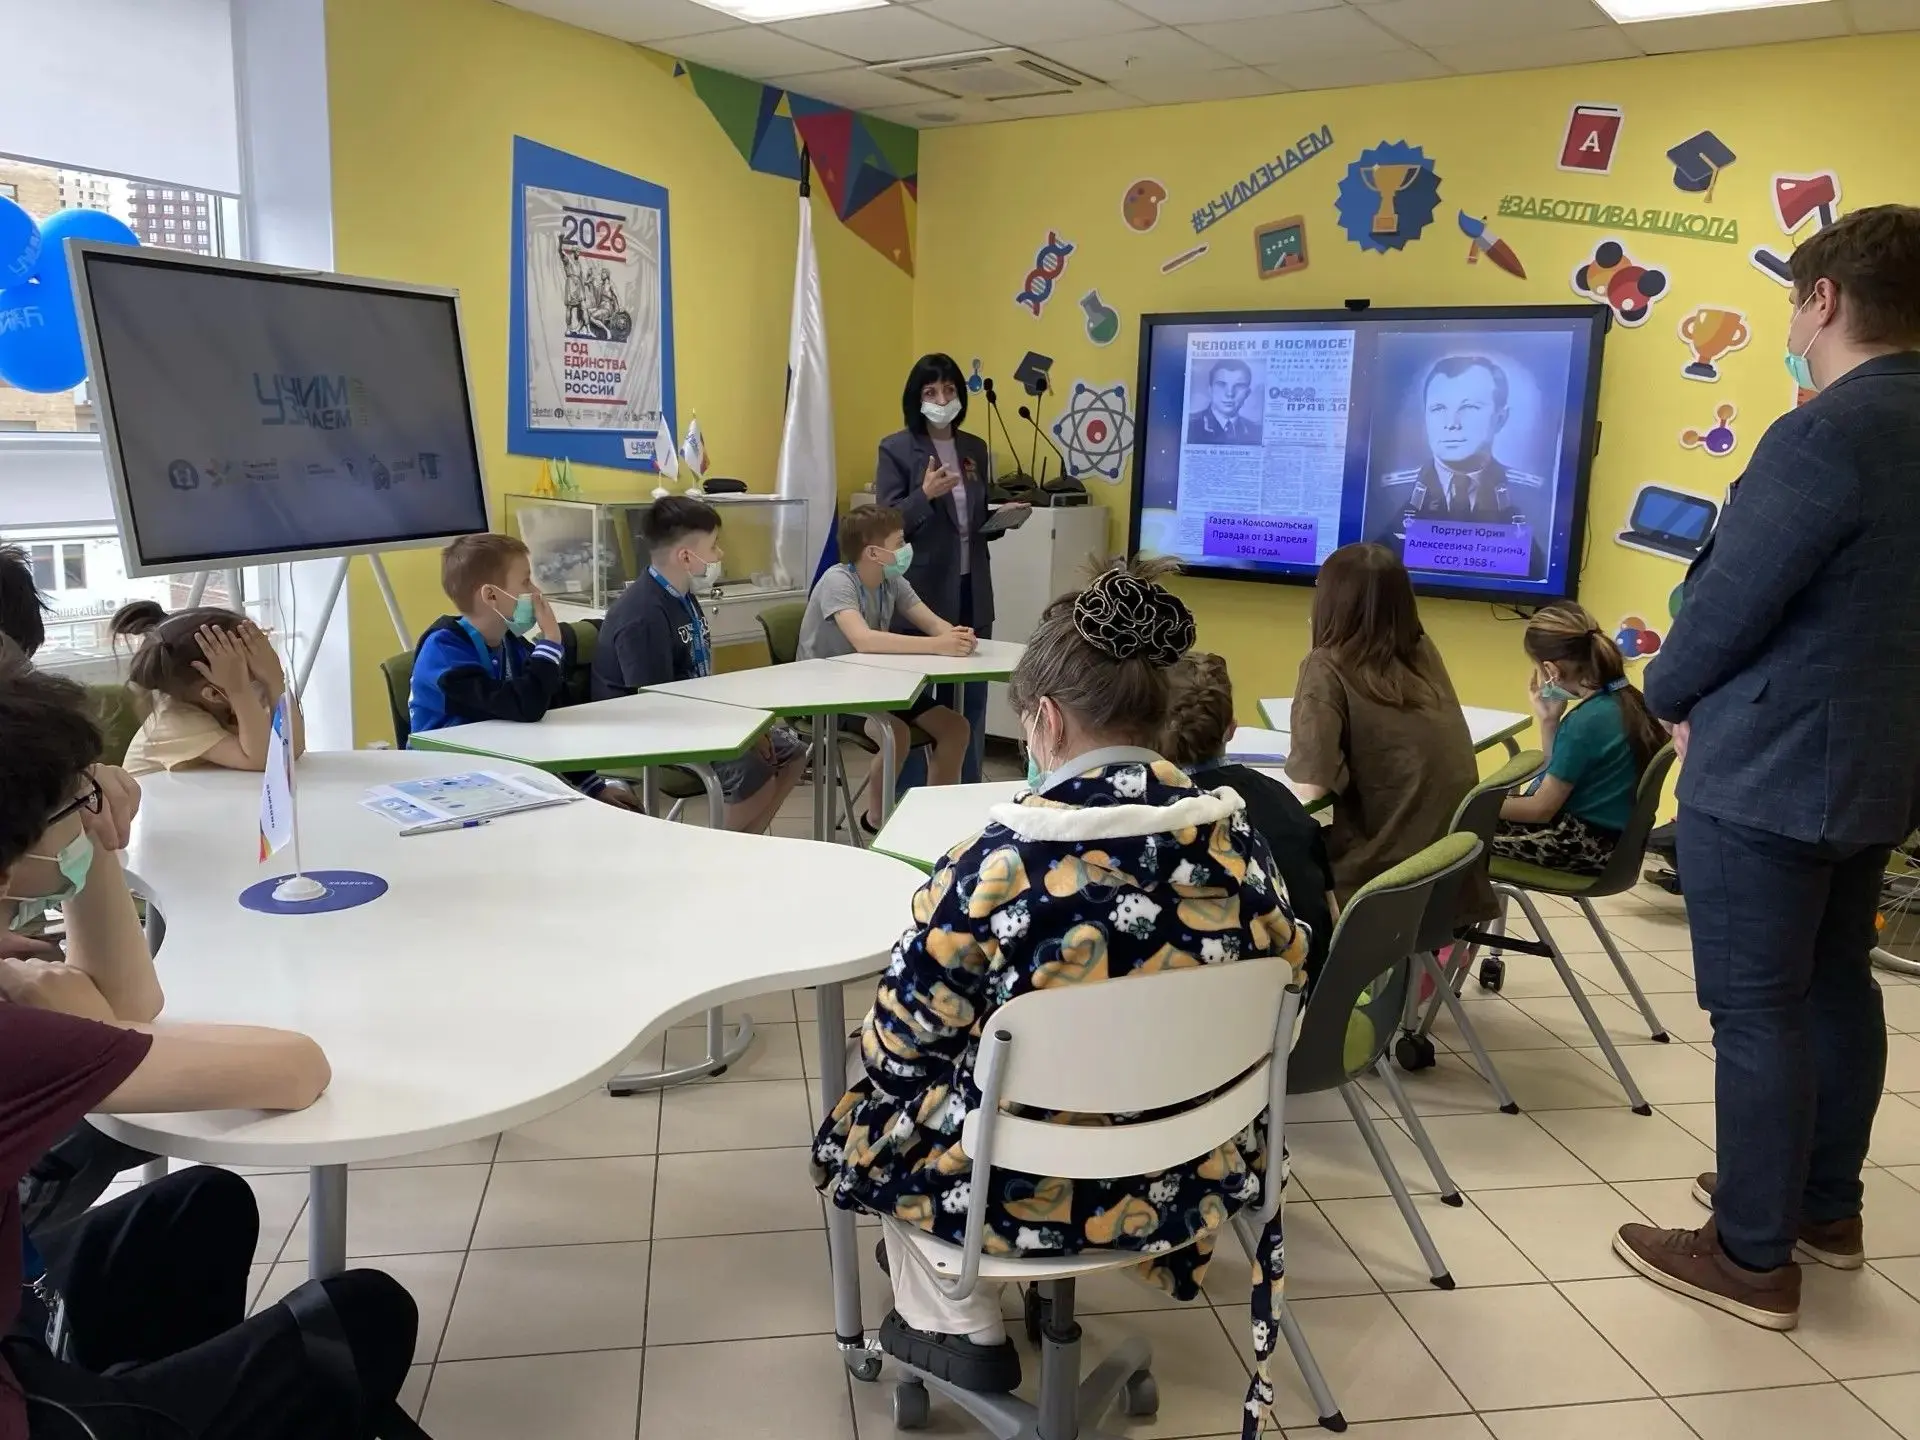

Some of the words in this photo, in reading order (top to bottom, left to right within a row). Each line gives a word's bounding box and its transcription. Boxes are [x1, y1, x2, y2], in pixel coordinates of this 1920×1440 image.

[1190, 124, 1334, 234] #УЧИМЗНАЕМ
[1497, 194, 1739, 244] #ЗАБОТЛИВАЯШКОЛА
[562, 215, 627, 253] 2026
[564, 342, 589, 355] ГОД
[564, 355, 627, 370] ЕДИНСТВА
[564, 369, 622, 384] НАРОДОВ
[564, 383, 615, 396] РОССИИ
[1209, 516, 1235, 526] Газета
[1238, 518, 1313, 531] «Комсомольская
[1212, 530, 1249, 541] Правда»
[1264, 533, 1274, 542] 13
[1275, 535, 1308, 545] апреля
[1431, 525, 1472, 536] Портрет
[1475, 528, 1505, 539] Юрия
[1236, 545, 1256, 554] 1961
[1258, 547, 1280, 557] года.
[1409, 540, 1473, 551] Алексеевича
[1476, 543, 1526, 557] Гагарина,
[1434, 555, 1460, 567] СССР,
[1463, 557, 1488, 567] 1968
